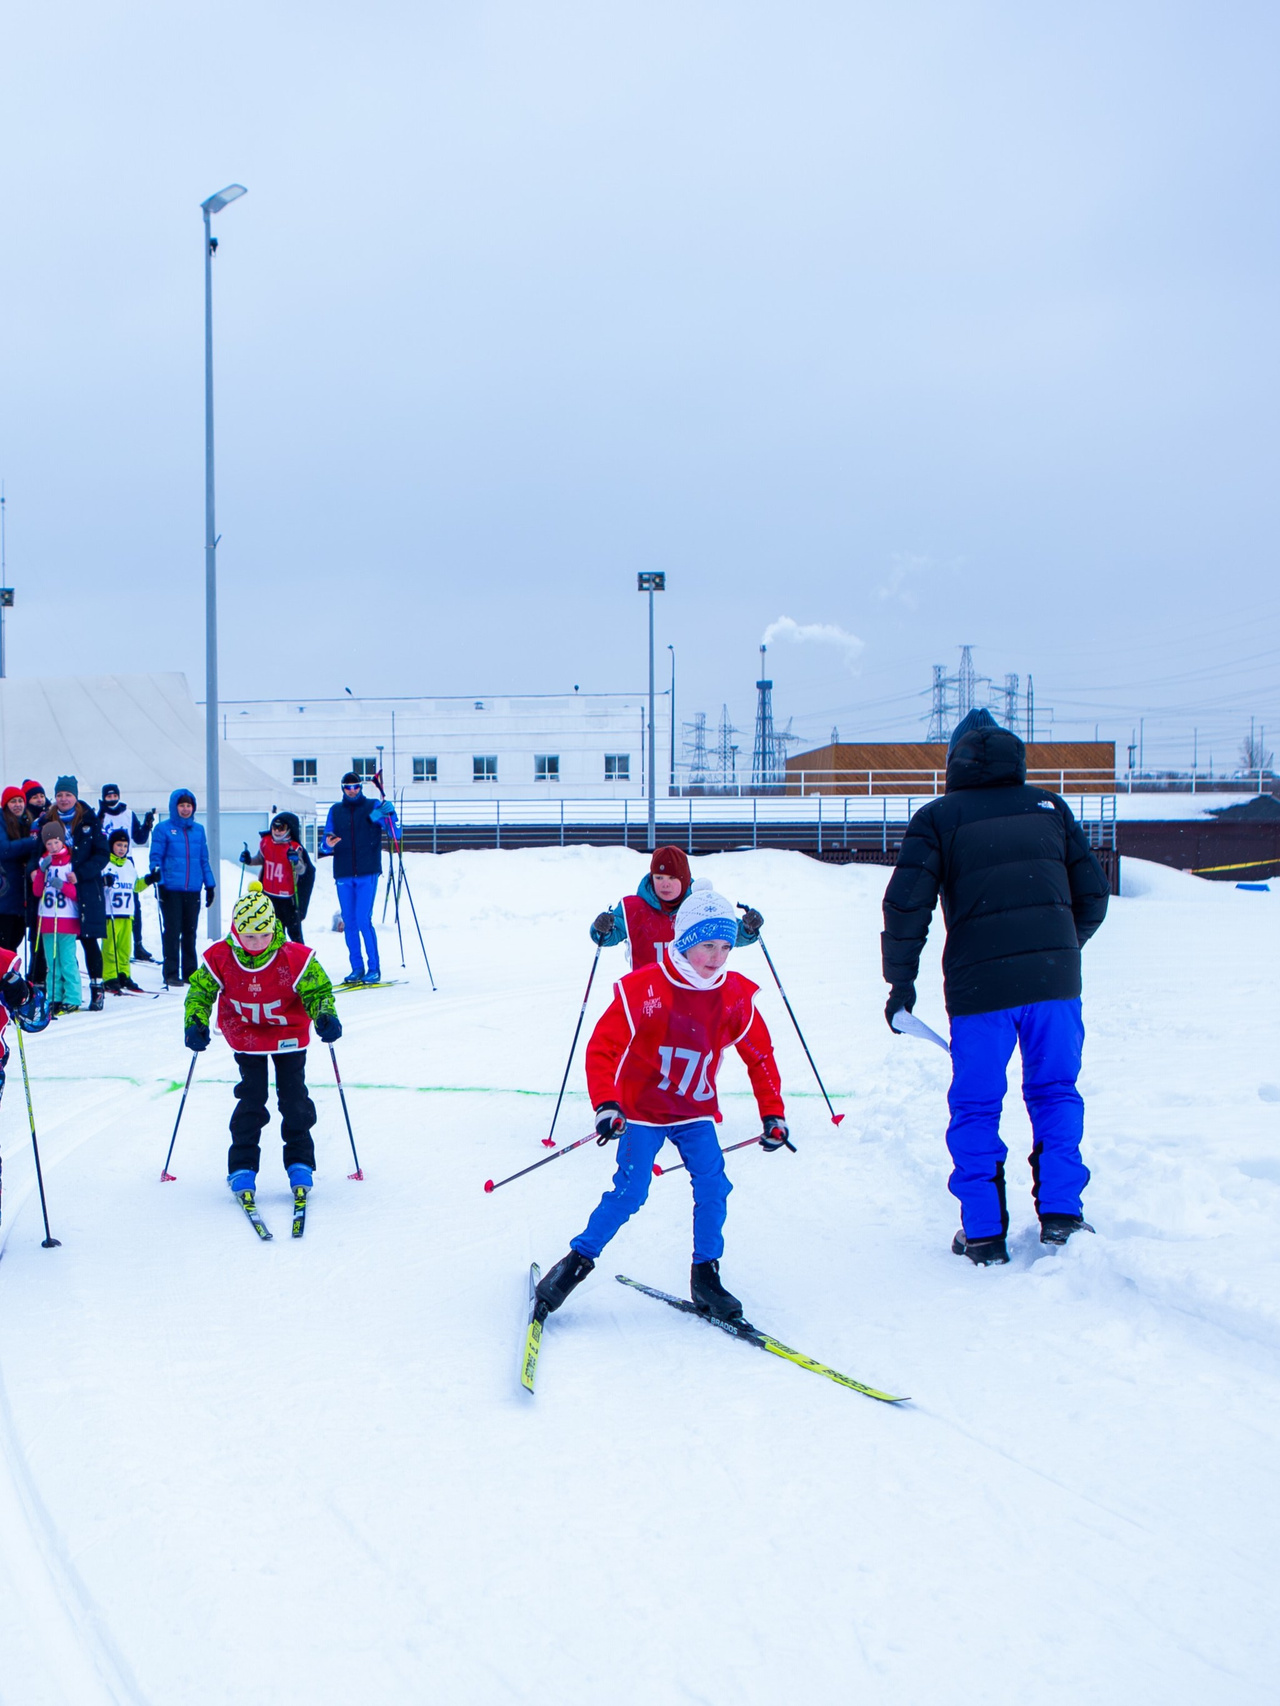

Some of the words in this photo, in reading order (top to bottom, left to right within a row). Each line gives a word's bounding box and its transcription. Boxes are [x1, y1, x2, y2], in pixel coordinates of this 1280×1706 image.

[44, 890, 67, 909] 68
[112, 892, 132, 909] 57
[230, 998, 288, 1026] 175
